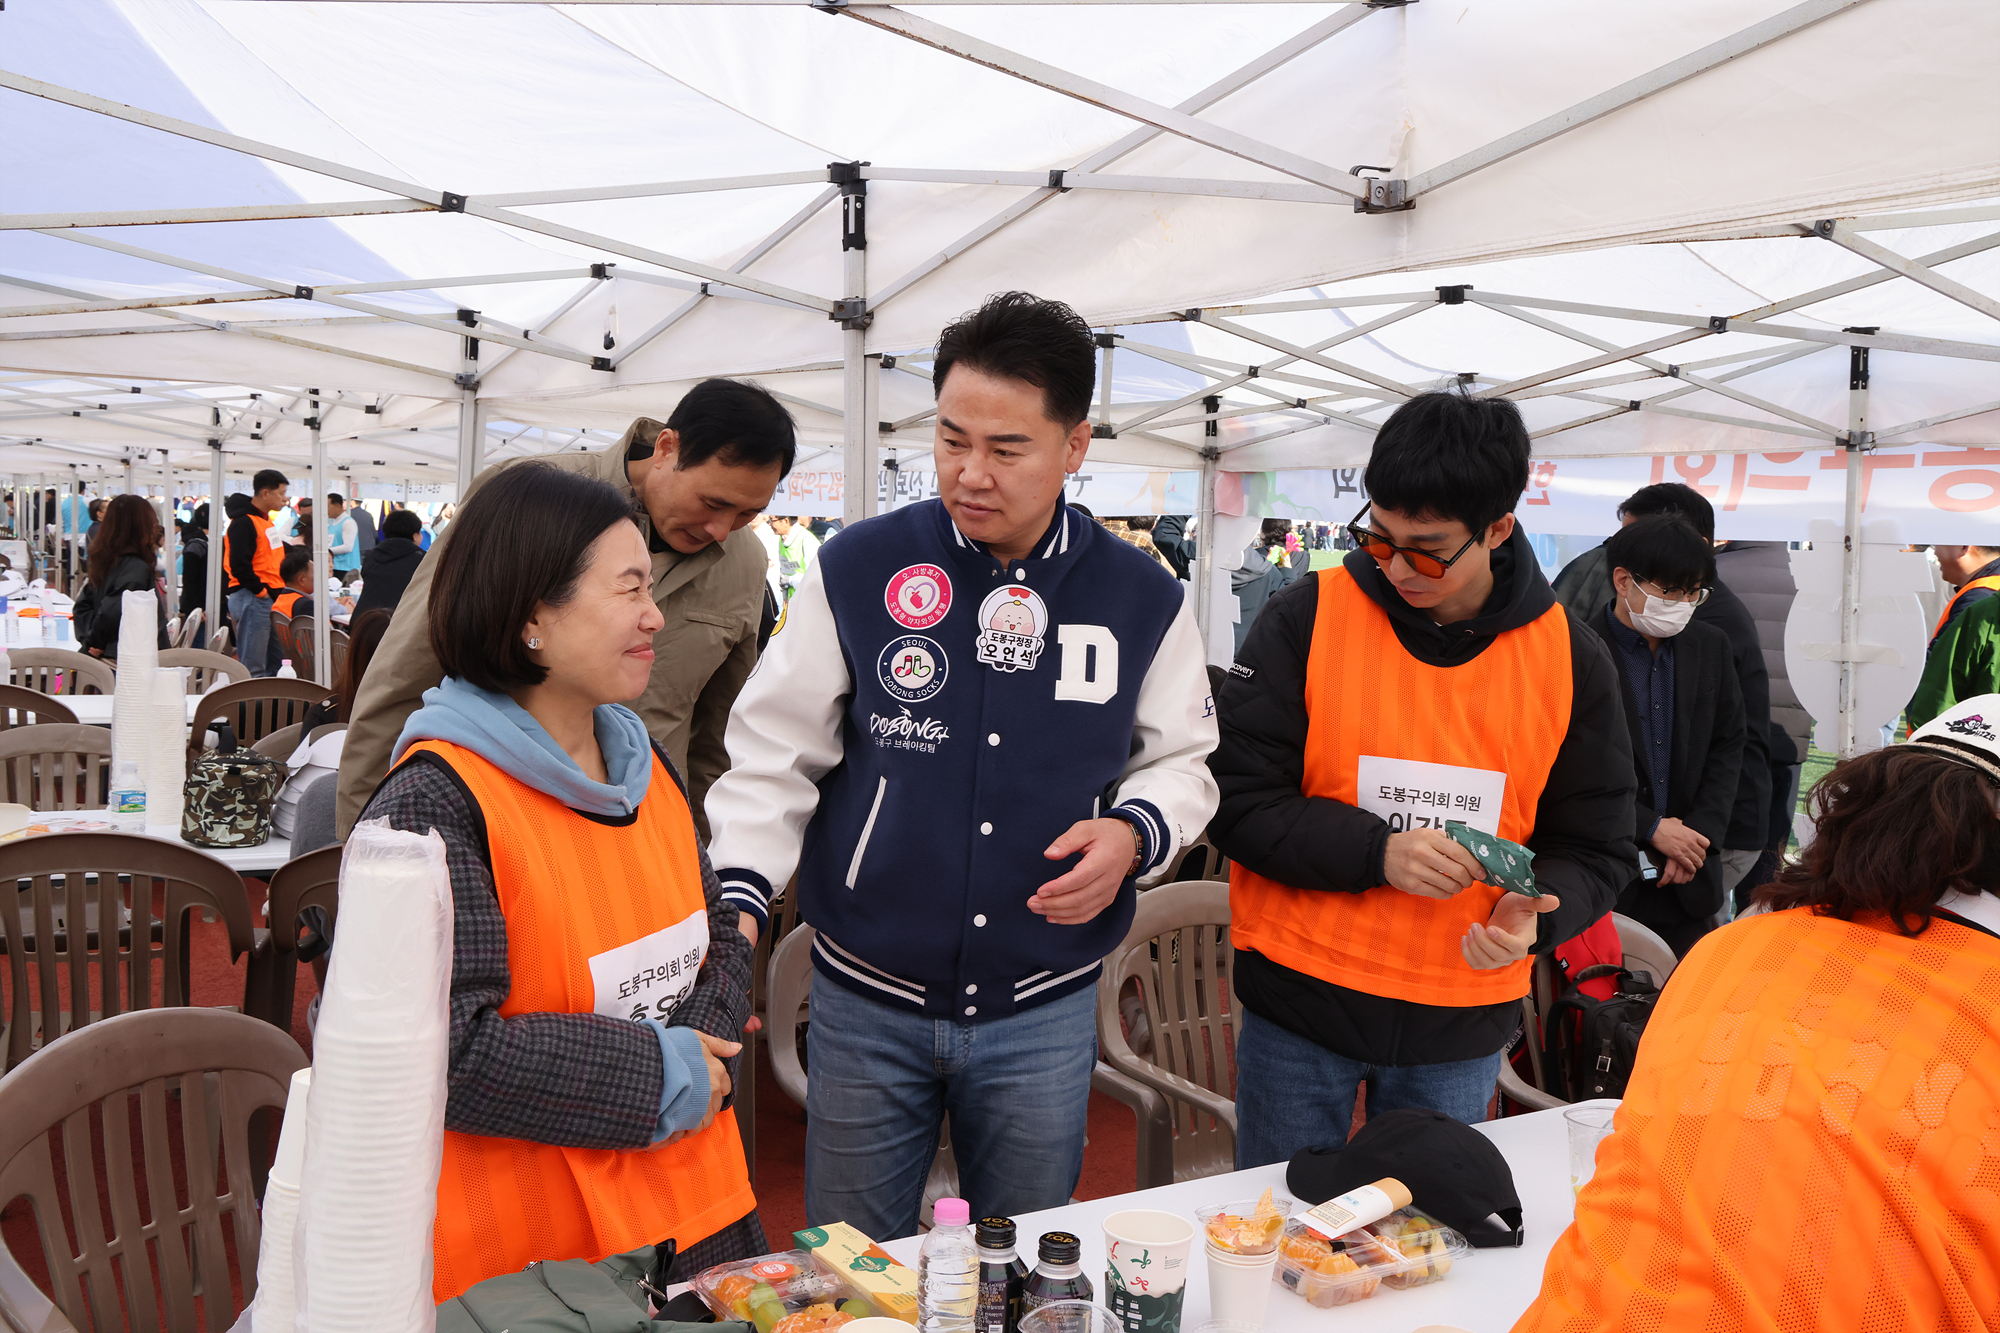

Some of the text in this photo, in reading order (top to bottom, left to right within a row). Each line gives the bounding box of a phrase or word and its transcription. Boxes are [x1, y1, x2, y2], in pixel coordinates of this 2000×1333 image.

[901, 639, 928, 649] SEOUL
[990, 632, 1033, 649] 도봉구청장
[1055, 623, 1118, 704] D
[883, 675, 940, 698] DOBONG SOCKS
[893, 739, 936, 754] 브레이킹팀
[1378, 785, 1482, 812] 도봉구의회 의원
[618, 945, 700, 1000] 도봉구의회 의원
